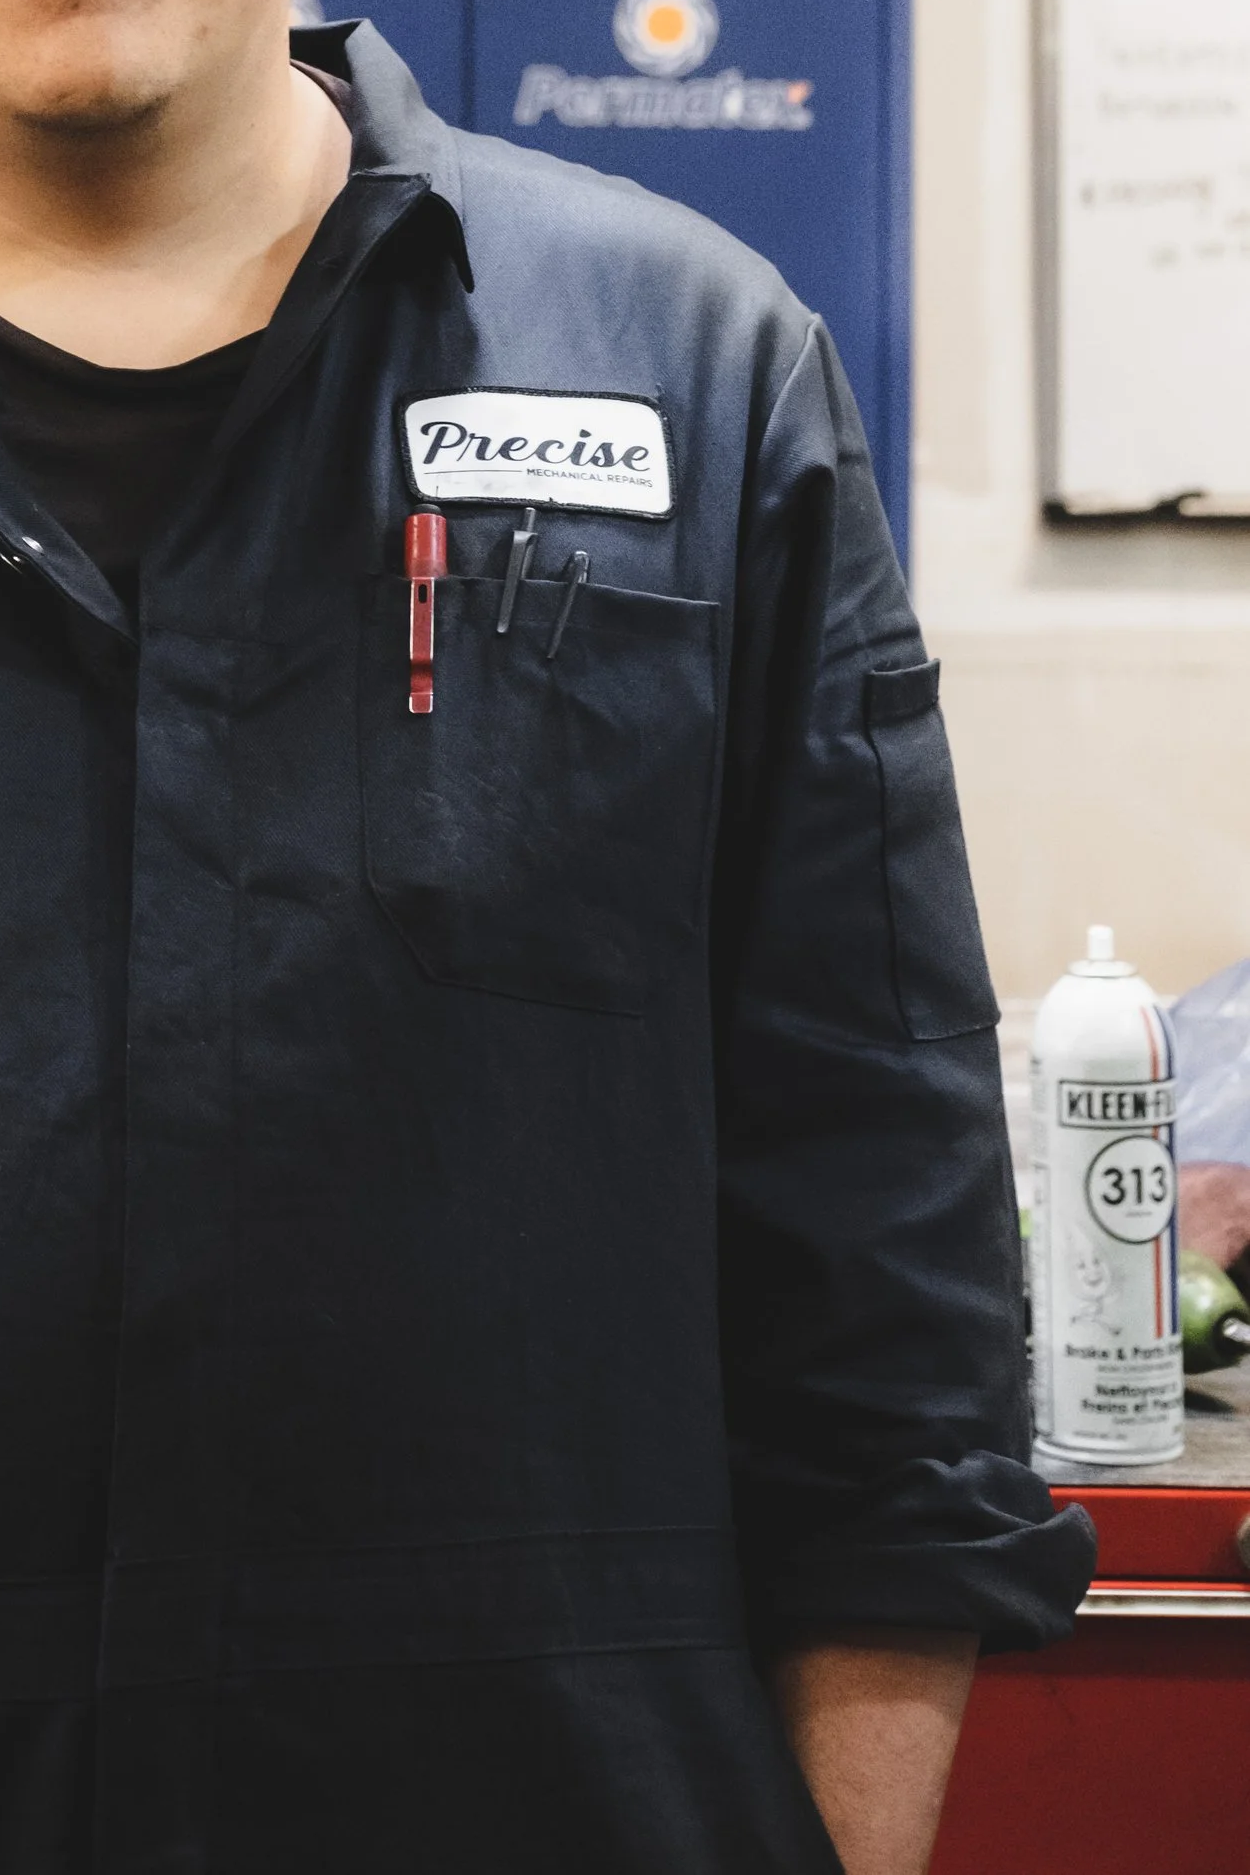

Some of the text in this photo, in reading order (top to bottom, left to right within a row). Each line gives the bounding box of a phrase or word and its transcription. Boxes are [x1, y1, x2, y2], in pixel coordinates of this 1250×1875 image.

[420, 421, 651, 472] Precise
[526, 468, 654, 488] MECHANICAL REPAIRS
[1102, 1165, 1167, 1205] 313
